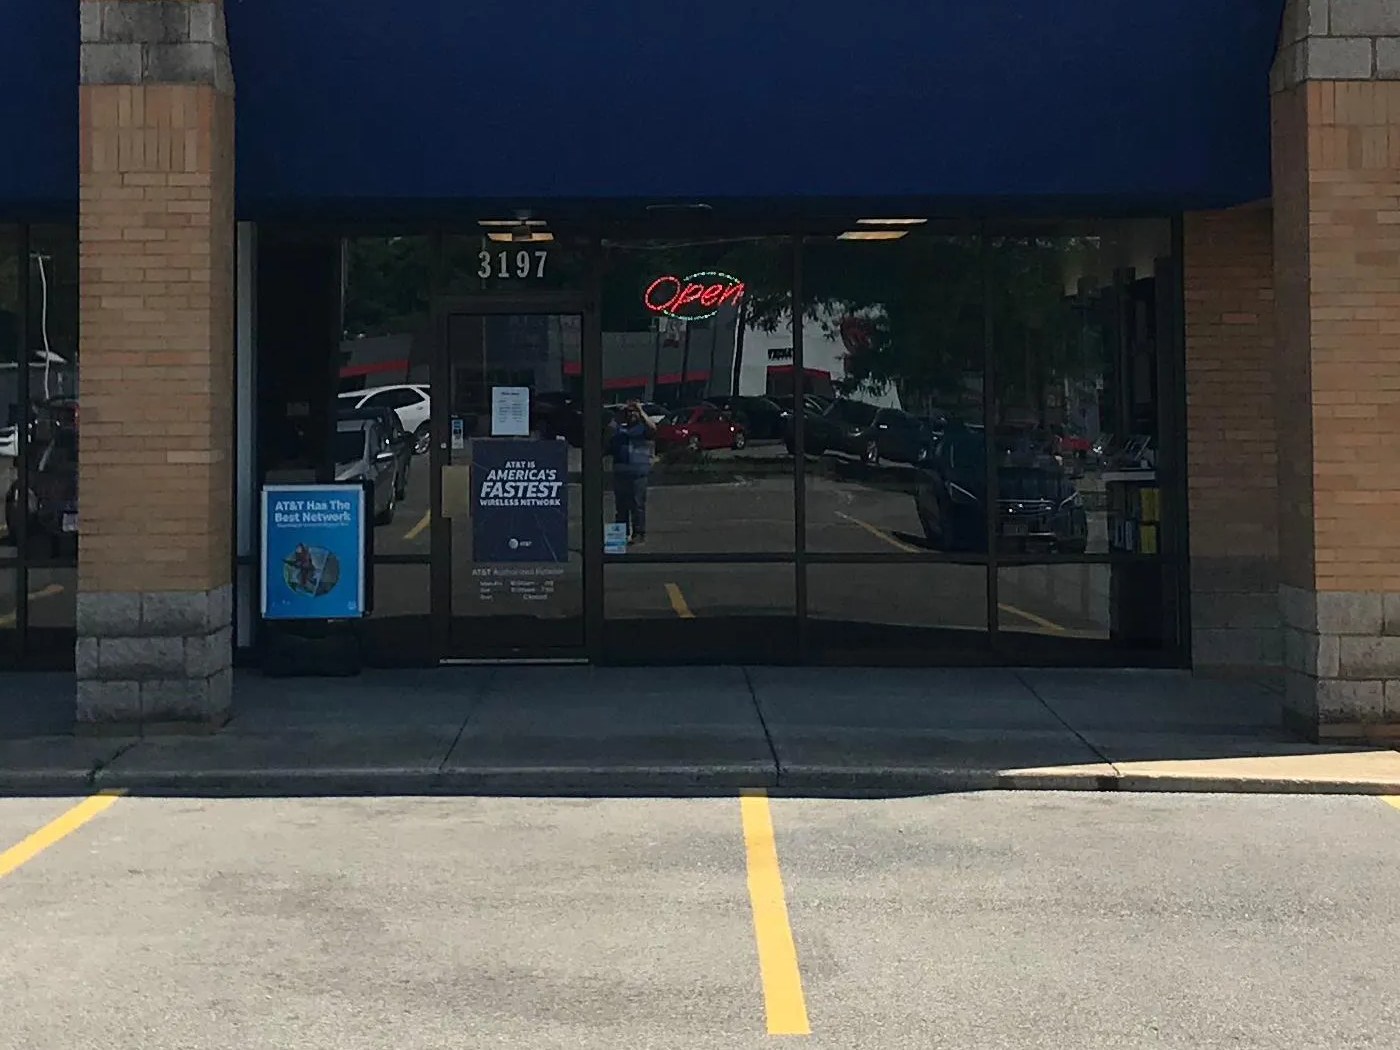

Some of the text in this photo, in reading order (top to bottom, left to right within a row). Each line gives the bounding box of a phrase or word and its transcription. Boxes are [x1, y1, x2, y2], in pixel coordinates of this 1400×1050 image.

[477, 250, 548, 278] 3197
[643, 275, 746, 313] Open
[486, 469, 557, 481] AMERICA'S
[480, 481, 563, 498] FASTEST
[274, 499, 351, 511] AT&T Has The
[479, 498, 561, 506] WIRELESS NETWORK
[274, 511, 352, 523] Best Network
